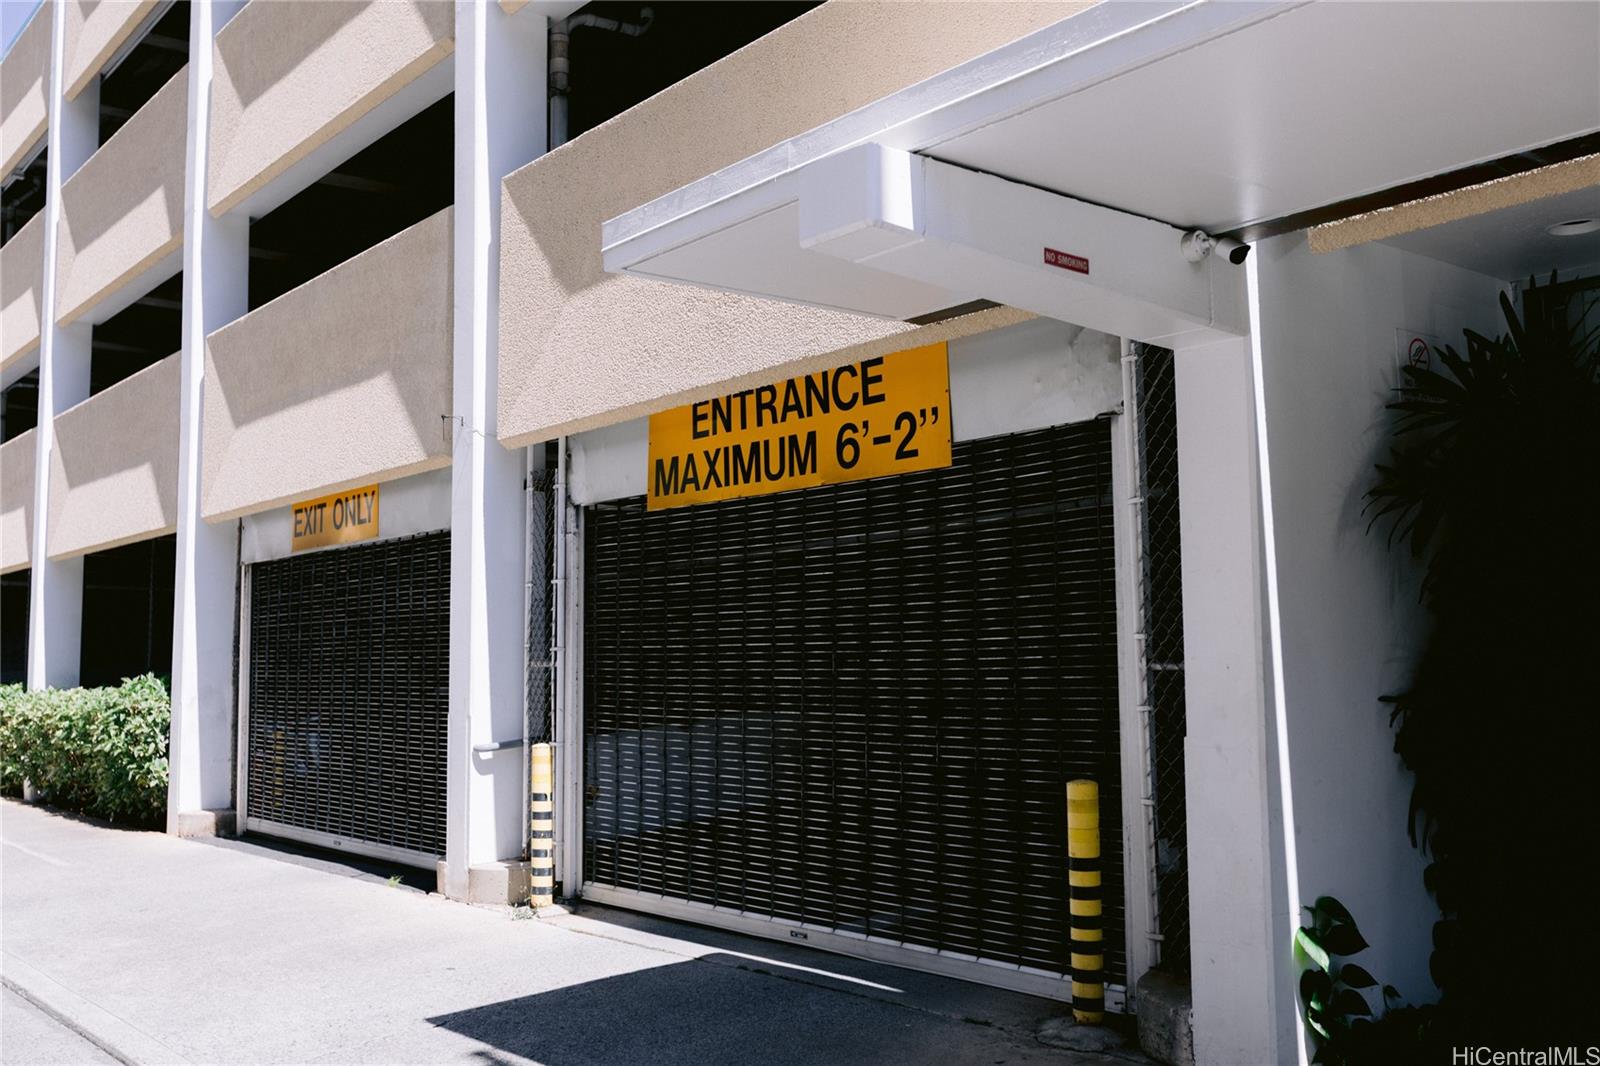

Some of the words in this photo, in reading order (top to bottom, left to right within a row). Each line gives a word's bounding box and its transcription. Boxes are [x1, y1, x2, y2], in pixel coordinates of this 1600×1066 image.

[1046, 251, 1056, 262] NO
[1057, 254, 1088, 271] SMOKING
[692, 357, 885, 440] ENTRANCE
[654, 430, 817, 497] MAXIMUM
[294, 502, 327, 538] EXIT
[333, 490, 376, 530] ONLY
